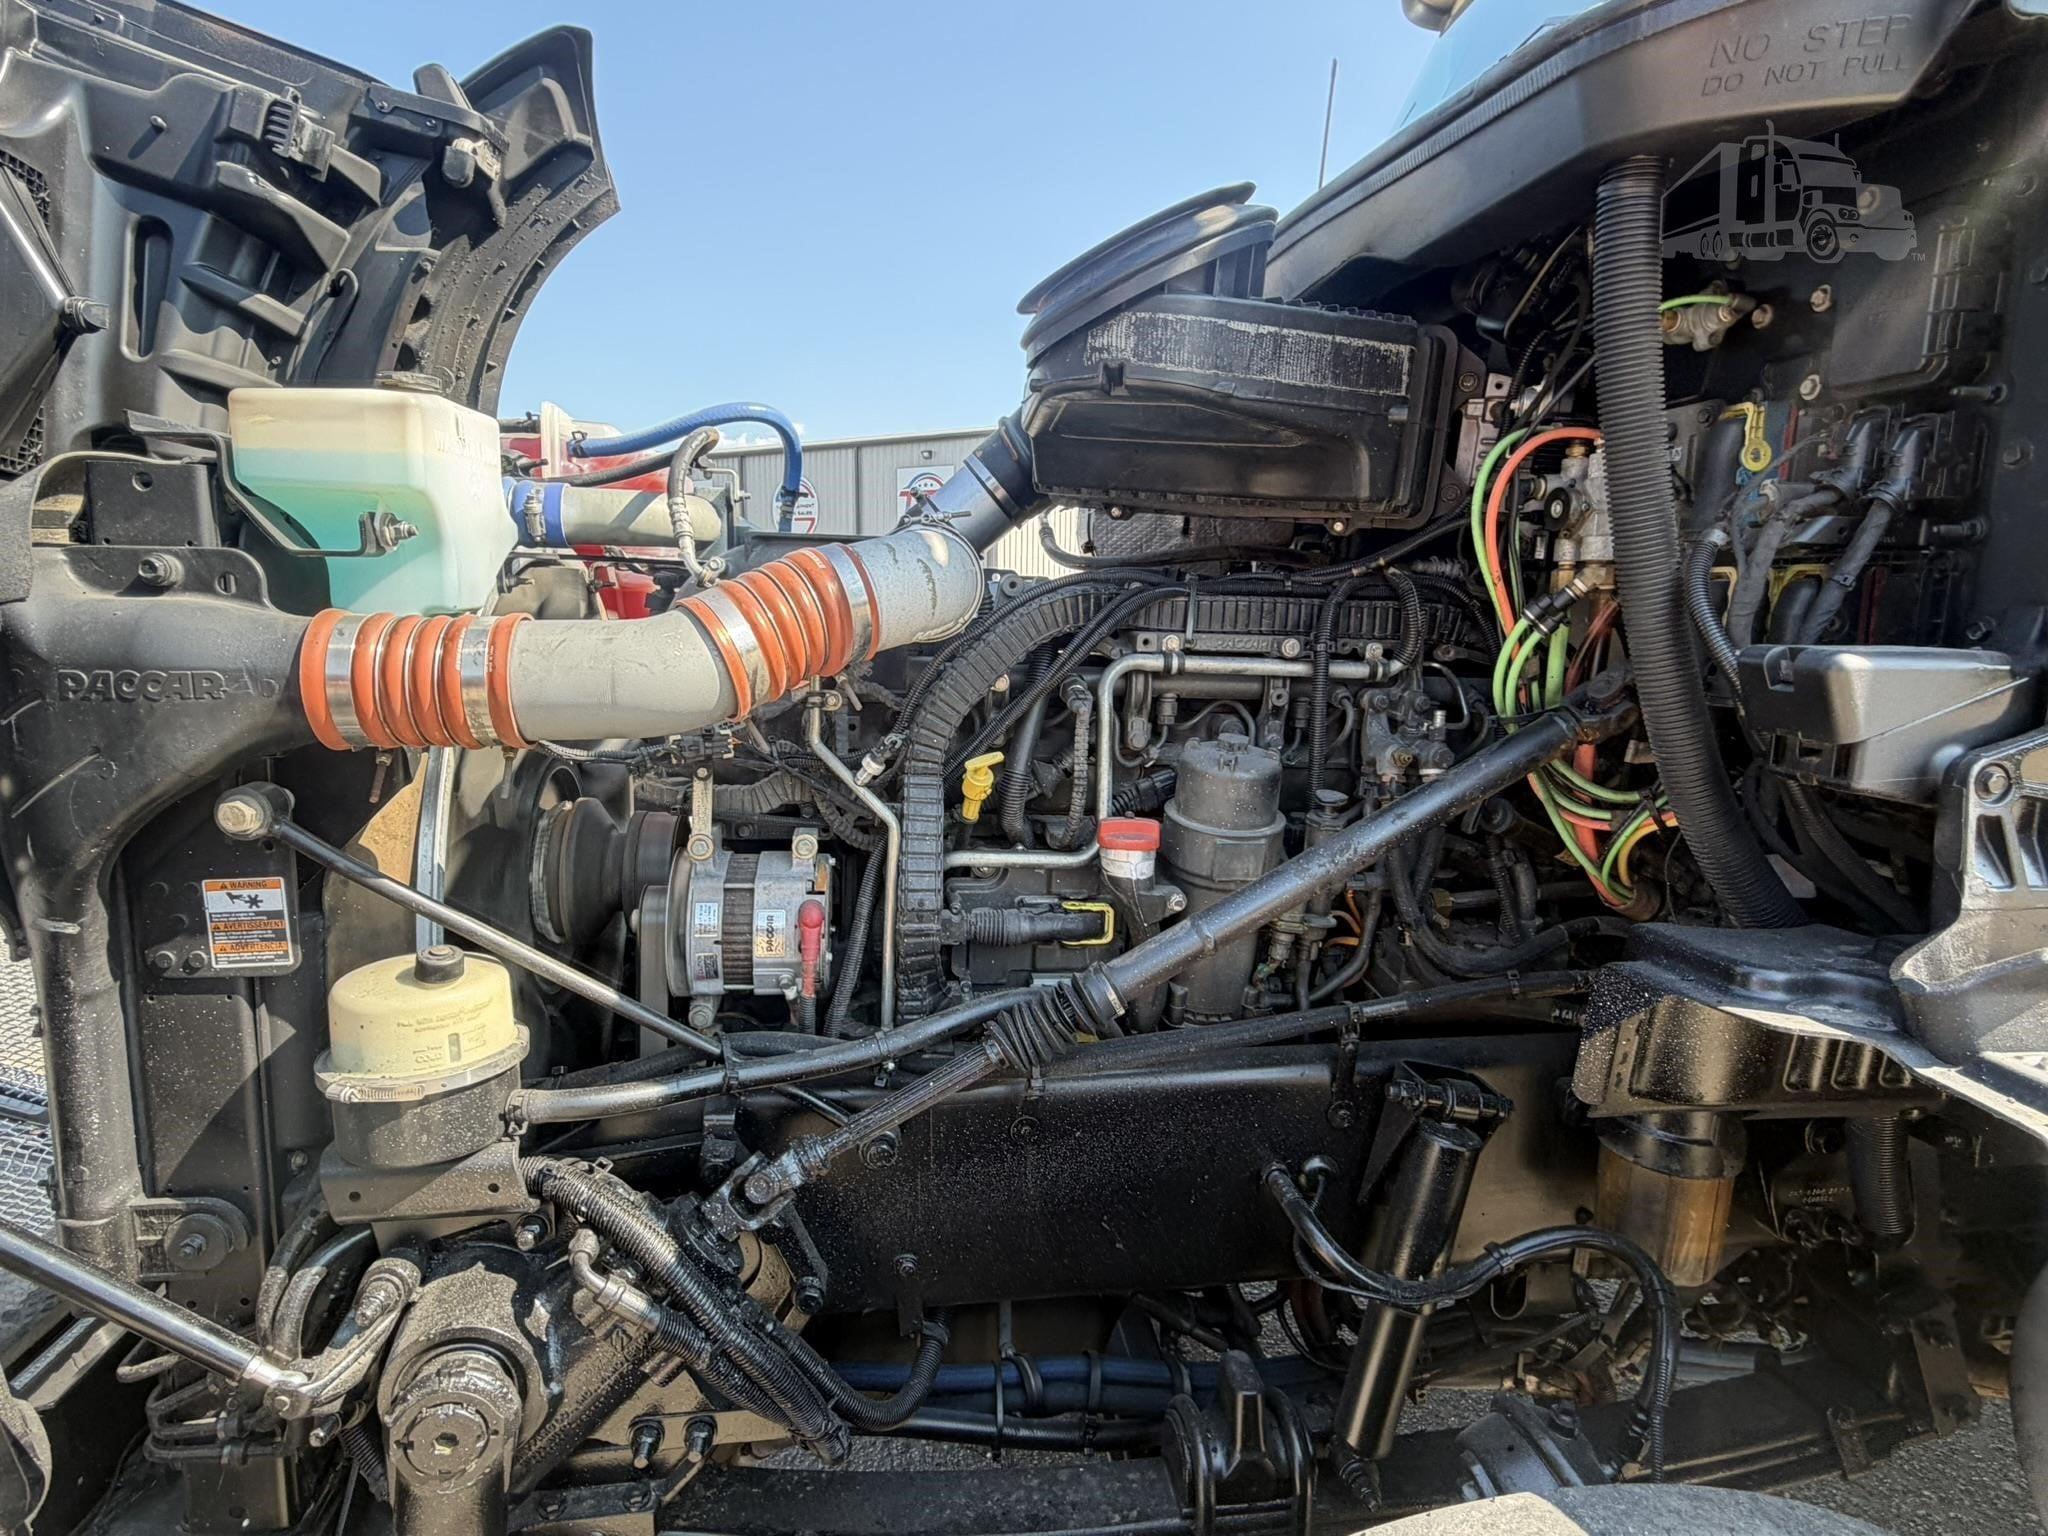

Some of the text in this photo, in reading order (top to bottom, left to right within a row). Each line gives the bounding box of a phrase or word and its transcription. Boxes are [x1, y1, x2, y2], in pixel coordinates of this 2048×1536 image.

[1709, 14, 1912, 68] NO STEP
[1701, 53, 1911, 97] DO NOT PULL
[57, 669, 226, 702] PACCAR
[229, 880, 268, 889] WARNING
[223, 920, 284, 930] AVERTISSEMENT
[766, 915, 775, 953] PACCAR
[230, 942, 284, 952] ADVERTENCIA
